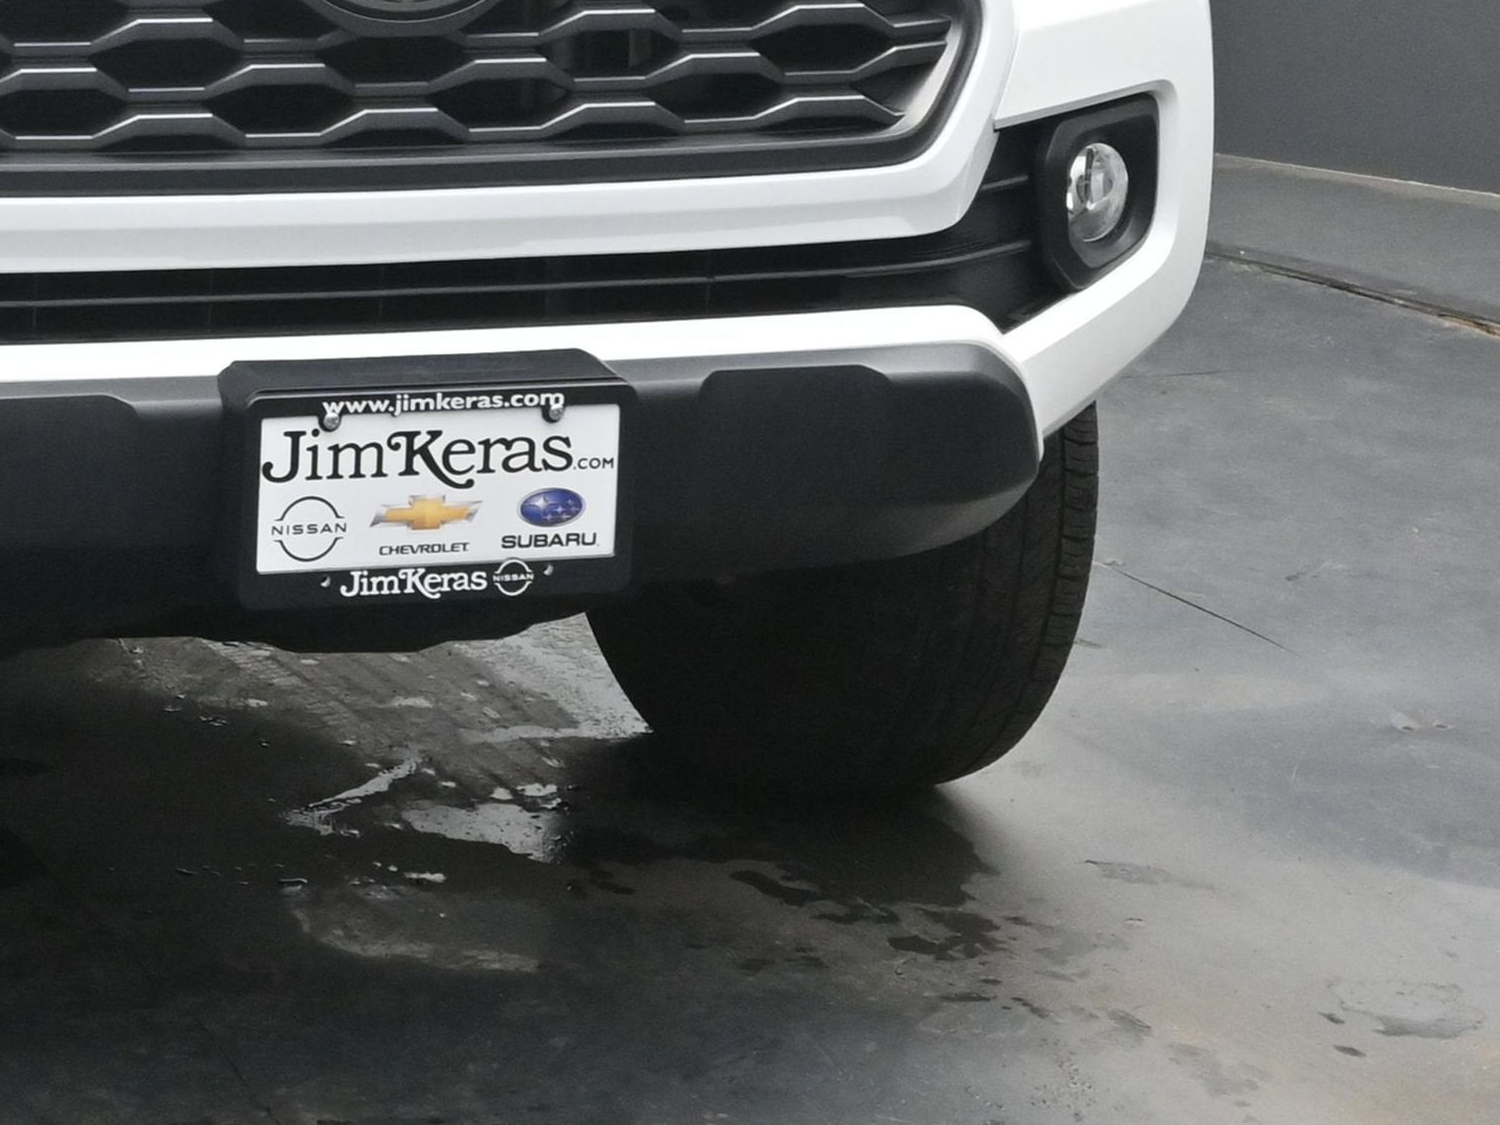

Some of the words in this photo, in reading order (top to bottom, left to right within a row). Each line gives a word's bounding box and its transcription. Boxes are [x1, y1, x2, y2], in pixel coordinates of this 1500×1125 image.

[322, 392, 565, 417] www.jimkeras.com
[271, 522, 347, 536] NISSAN
[501, 532, 597, 549] SUBARU
[379, 542, 469, 556] CHEVROLET
[492, 573, 534, 582] NISSAN
